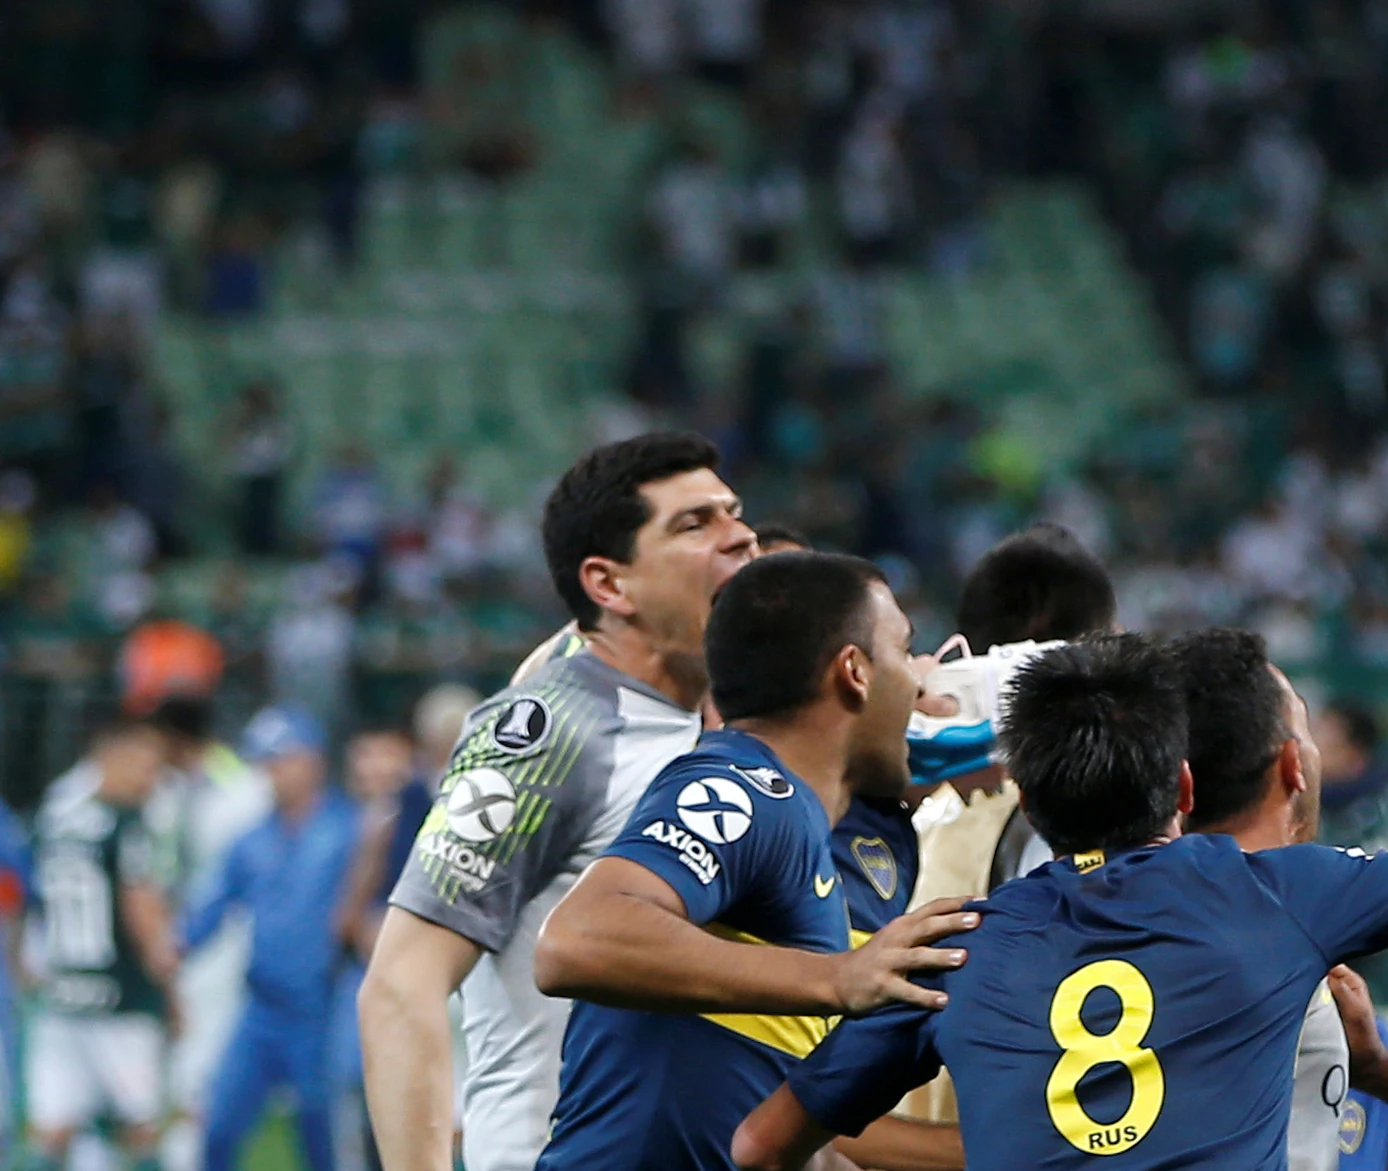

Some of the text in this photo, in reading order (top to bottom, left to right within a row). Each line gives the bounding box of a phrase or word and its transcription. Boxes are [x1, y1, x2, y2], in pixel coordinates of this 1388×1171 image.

[419, 832, 496, 880] AXION
[641, 820, 721, 879] AXION
[1045, 959, 1165, 1156] 8
[1089, 1126, 1138, 1150] RUS
